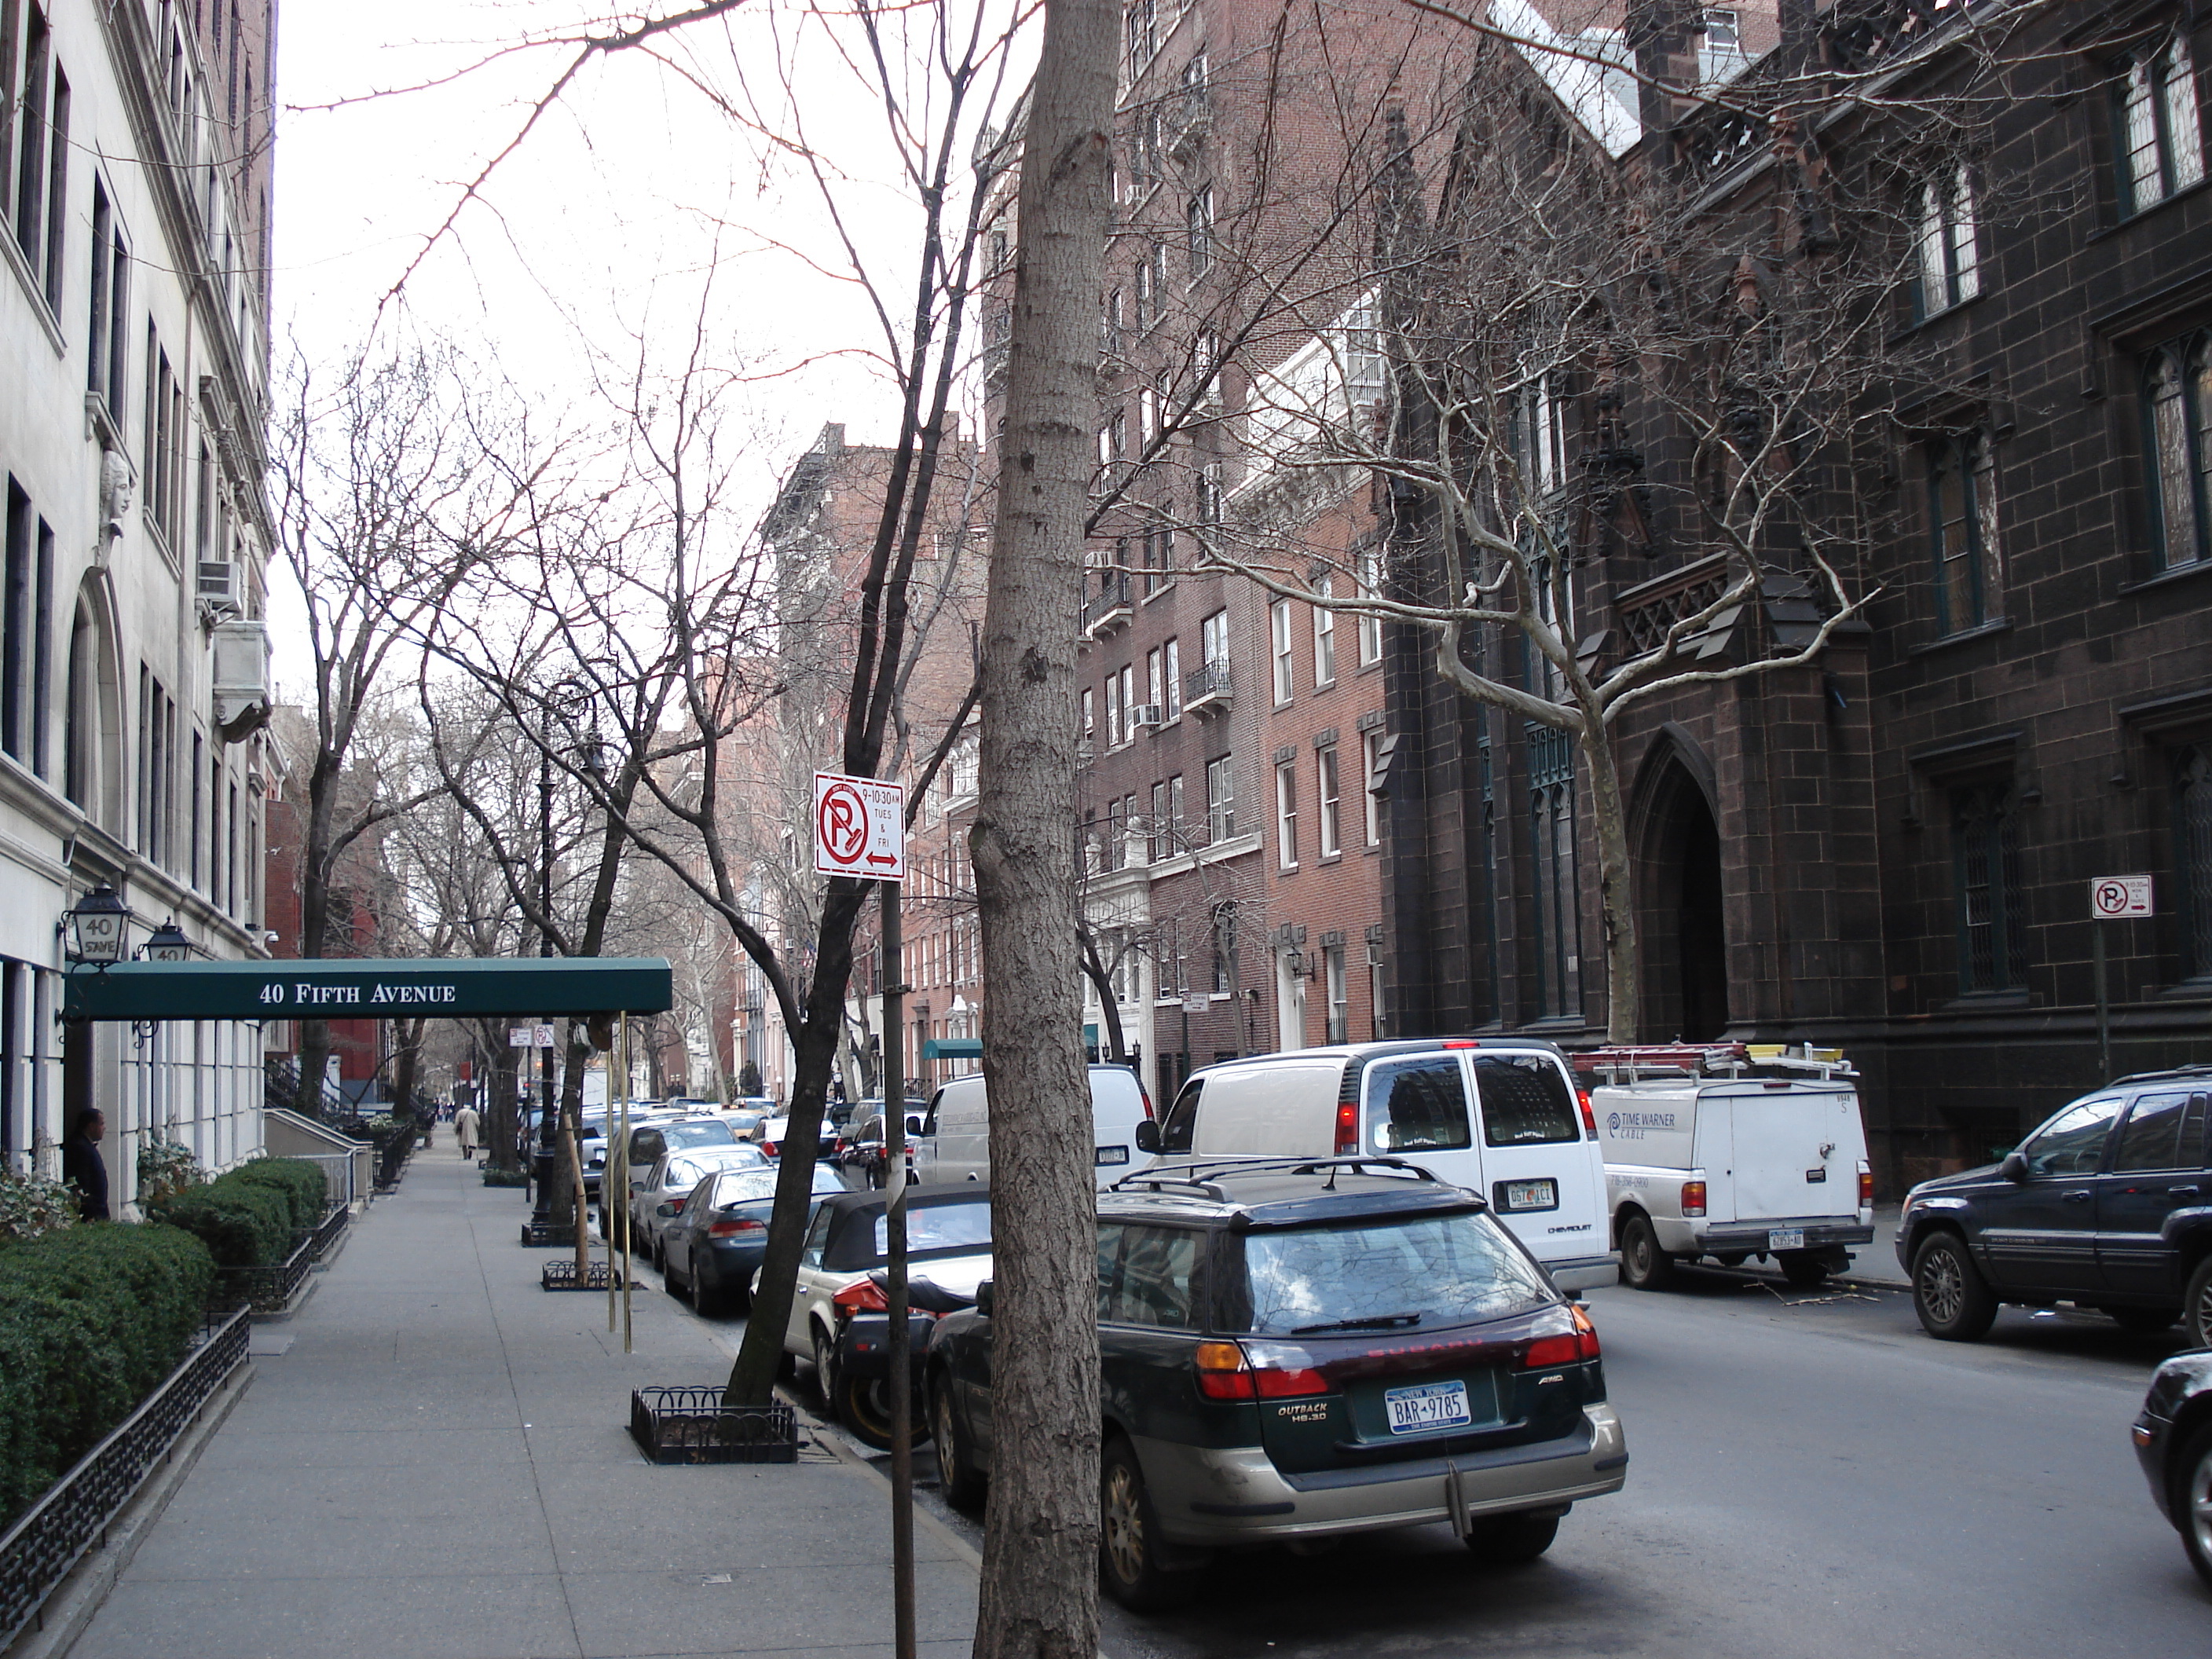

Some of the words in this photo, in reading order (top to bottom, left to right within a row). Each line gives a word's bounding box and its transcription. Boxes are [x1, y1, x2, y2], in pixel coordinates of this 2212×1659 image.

[874, 808, 892, 819] TUES
[881, 824, 885, 833] &
[877, 837, 889, 848] FRI
[86, 918, 112, 936] 40
[157, 950, 178, 961] 40
[259, 983, 284, 1004] 40
[295, 983, 361, 1004] FIFTH
[370, 983, 456, 1003] AVENUE
[1841, 1102, 1847, 1113] S
[1622, 1112, 1640, 1126] TIME
[1642, 1113, 1675, 1126] WARNER
[1621, 1129, 1645, 1140] CABLE
[1547, 1224, 1592, 1234] CHEVROLET
[1368, 1338, 1483, 1357] SUBARU
[1538, 1374, 1564, 1385] AWD
[1405, 1389, 1423, 1400] NEW
[1423, 1386, 1446, 1397] YORK
[1278, 1402, 1328, 1416] OUTBACK
